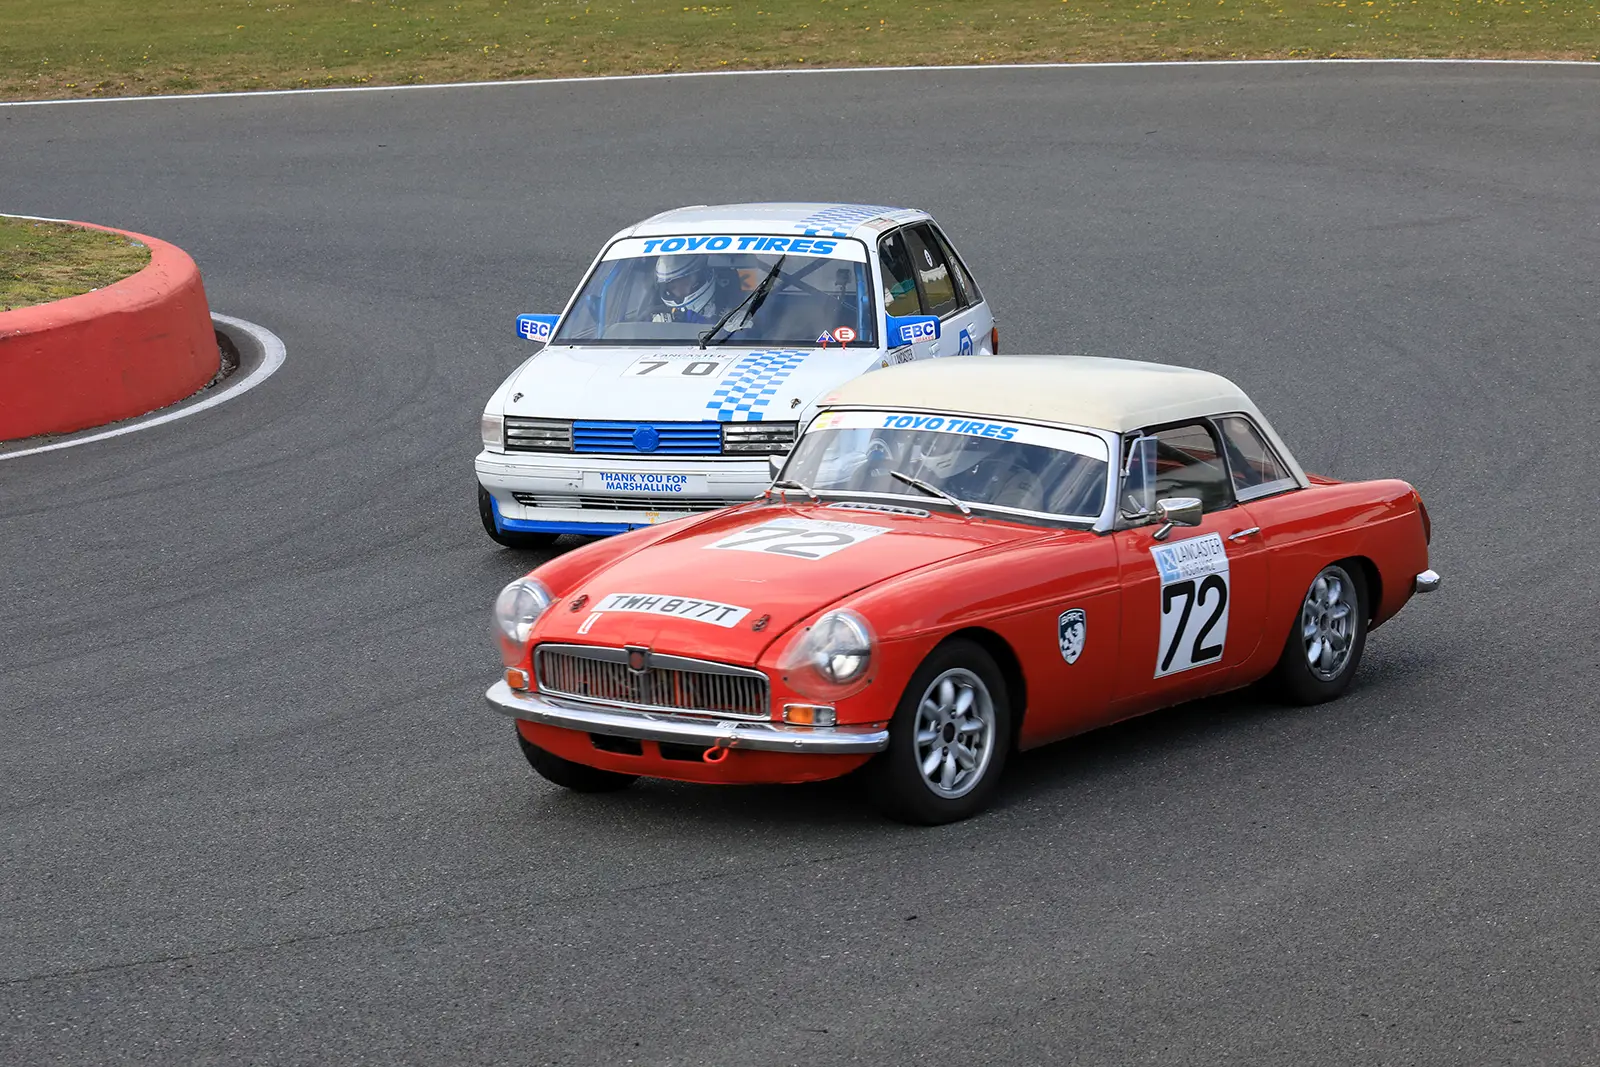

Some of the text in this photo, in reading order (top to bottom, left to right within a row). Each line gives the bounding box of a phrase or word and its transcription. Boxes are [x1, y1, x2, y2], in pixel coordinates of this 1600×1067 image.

[643, 237, 838, 254] TOYO TIRES
[521, 320, 549, 337] EBC
[839, 329, 850, 340] E
[901, 323, 934, 339] EBC
[882, 415, 1019, 441] TOYO TIRES
[600, 472, 687, 484] THANK YOU FOR
[606, 482, 682, 493] MARSHALLING
[716, 526, 855, 558] 72
[1174, 538, 1223, 564] LANCASTER
[608, 595, 738, 622] TWH 877T
[1161, 574, 1228, 672] 72
